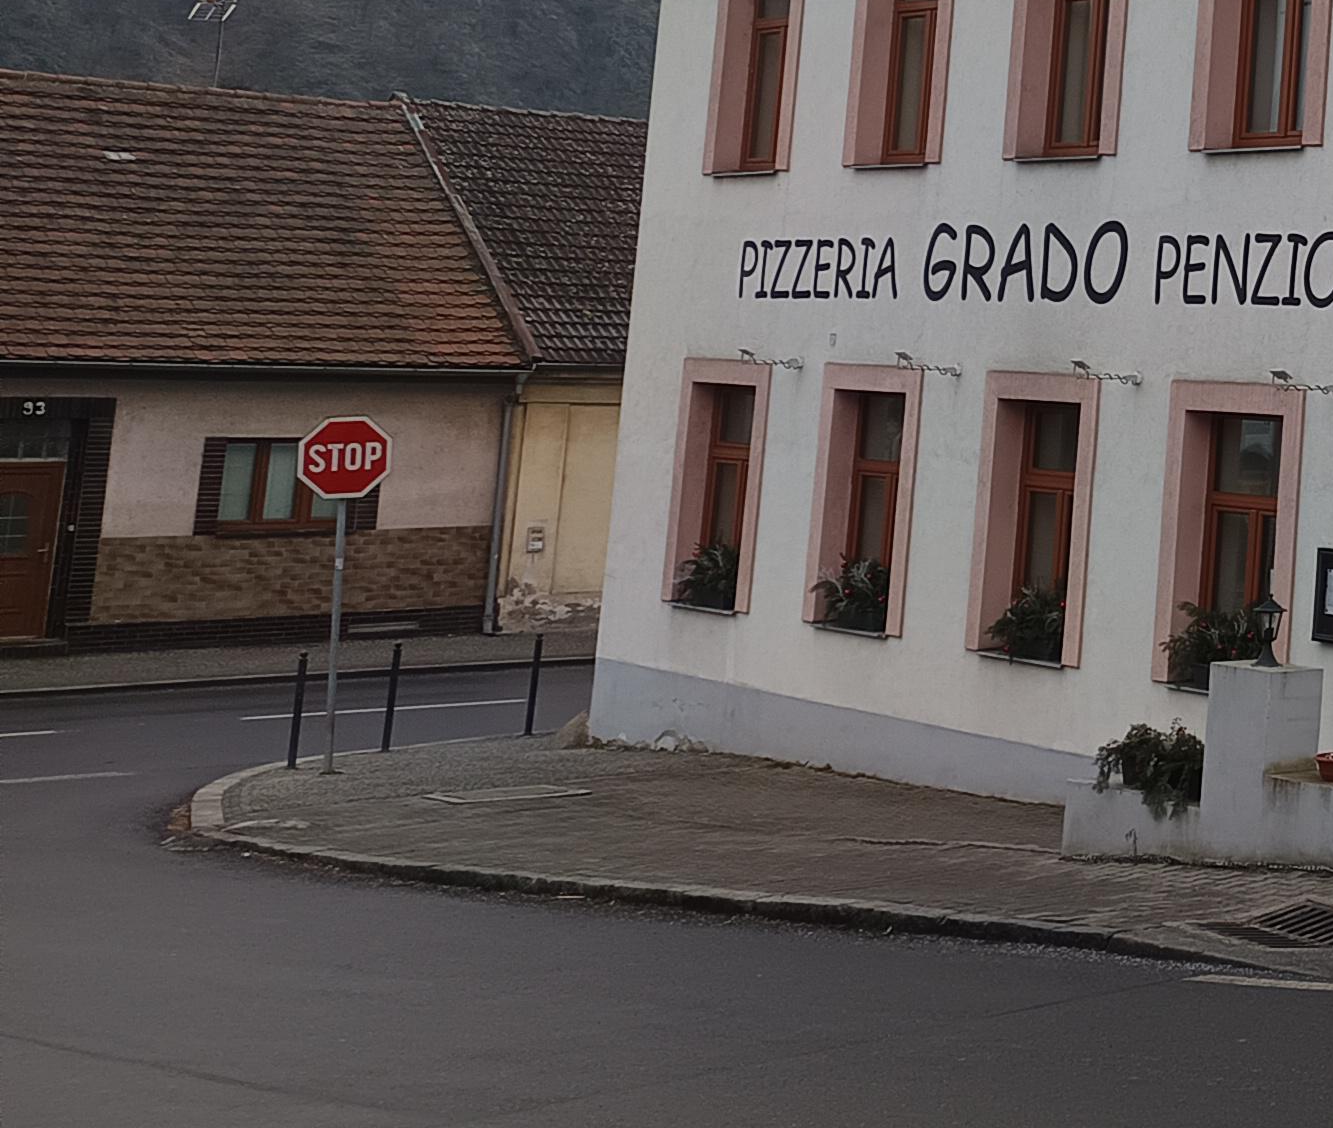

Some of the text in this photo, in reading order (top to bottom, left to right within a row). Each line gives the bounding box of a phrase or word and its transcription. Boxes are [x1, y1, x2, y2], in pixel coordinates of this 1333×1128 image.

[738, 237, 898, 299] PIZZERIA
[922, 220, 1128, 303] GRADO
[22, 401, 46, 415] 93
[308, 441, 383, 473] STOP
